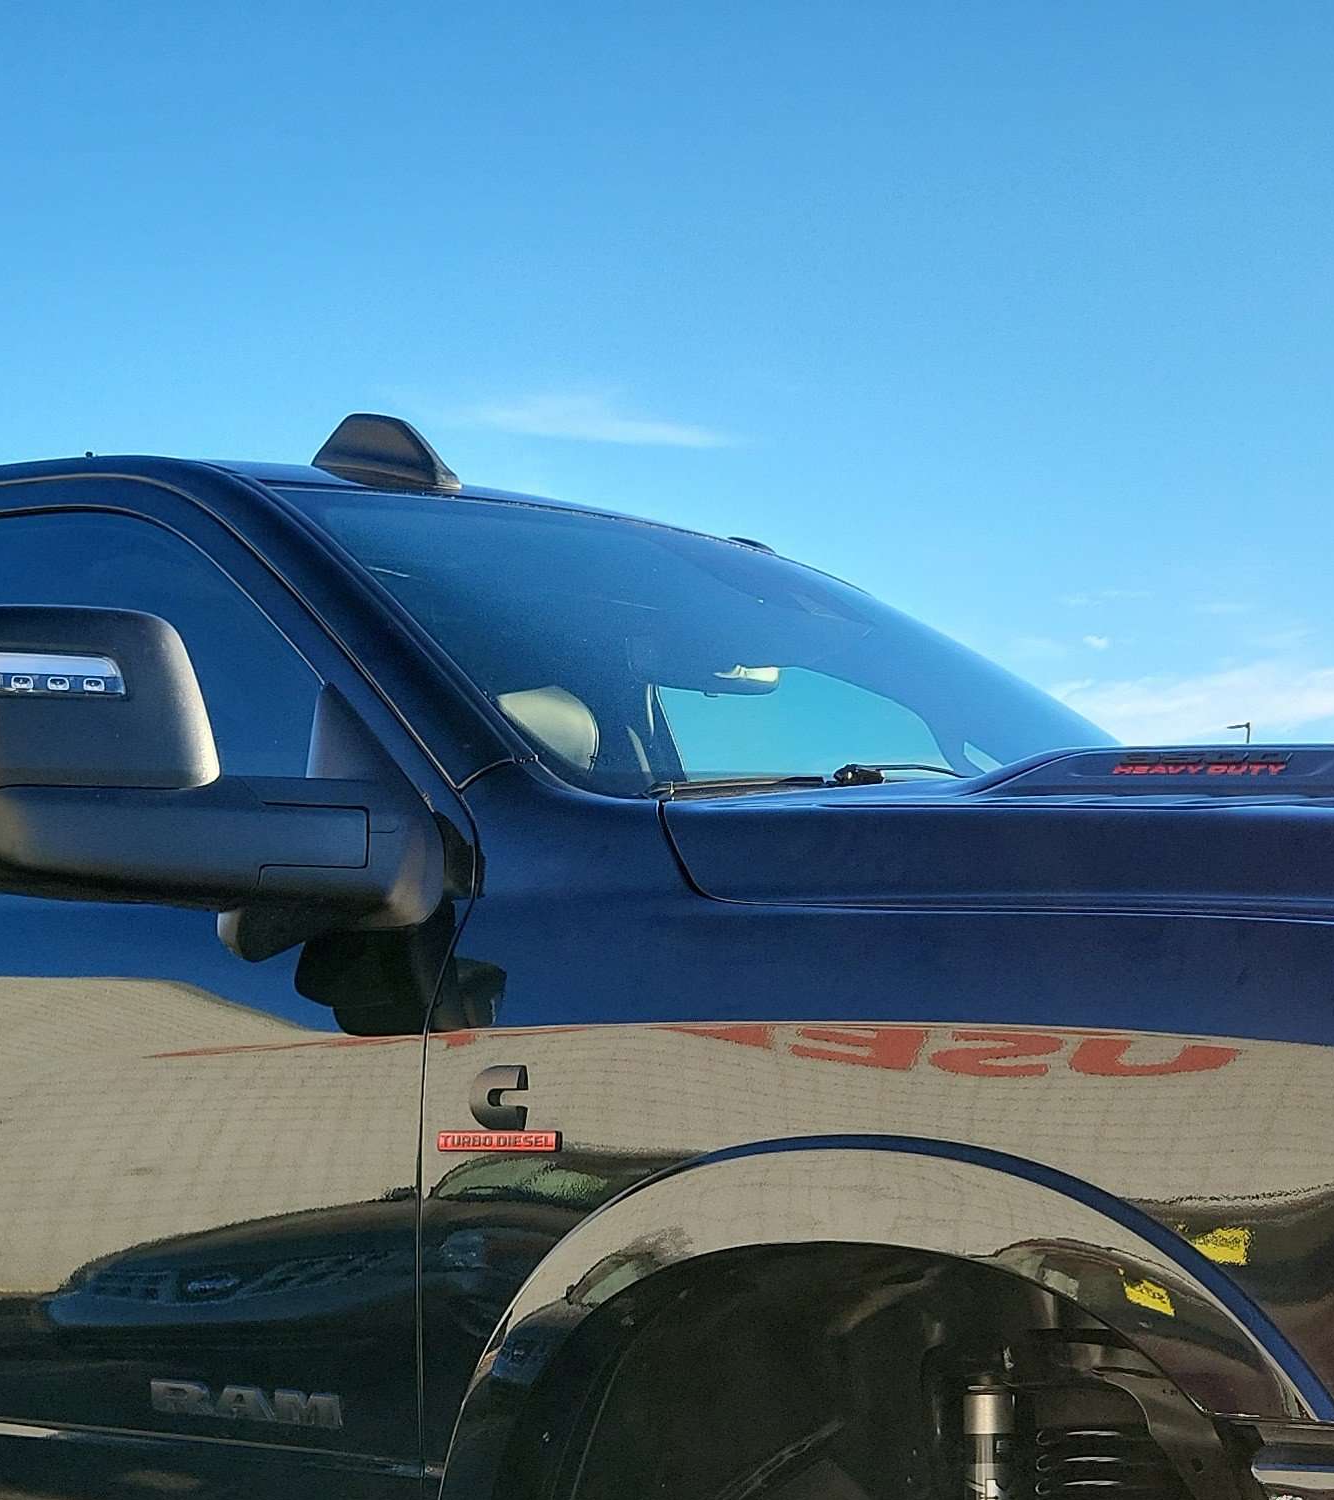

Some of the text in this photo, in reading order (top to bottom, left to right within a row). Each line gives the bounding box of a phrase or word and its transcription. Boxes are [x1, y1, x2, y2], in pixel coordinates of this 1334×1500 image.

[1112, 763, 1287, 776] HEAVY DUTY
[440, 1135, 554, 1148] TURBO DIESEL
[150, 1378, 344, 1430] RAM
